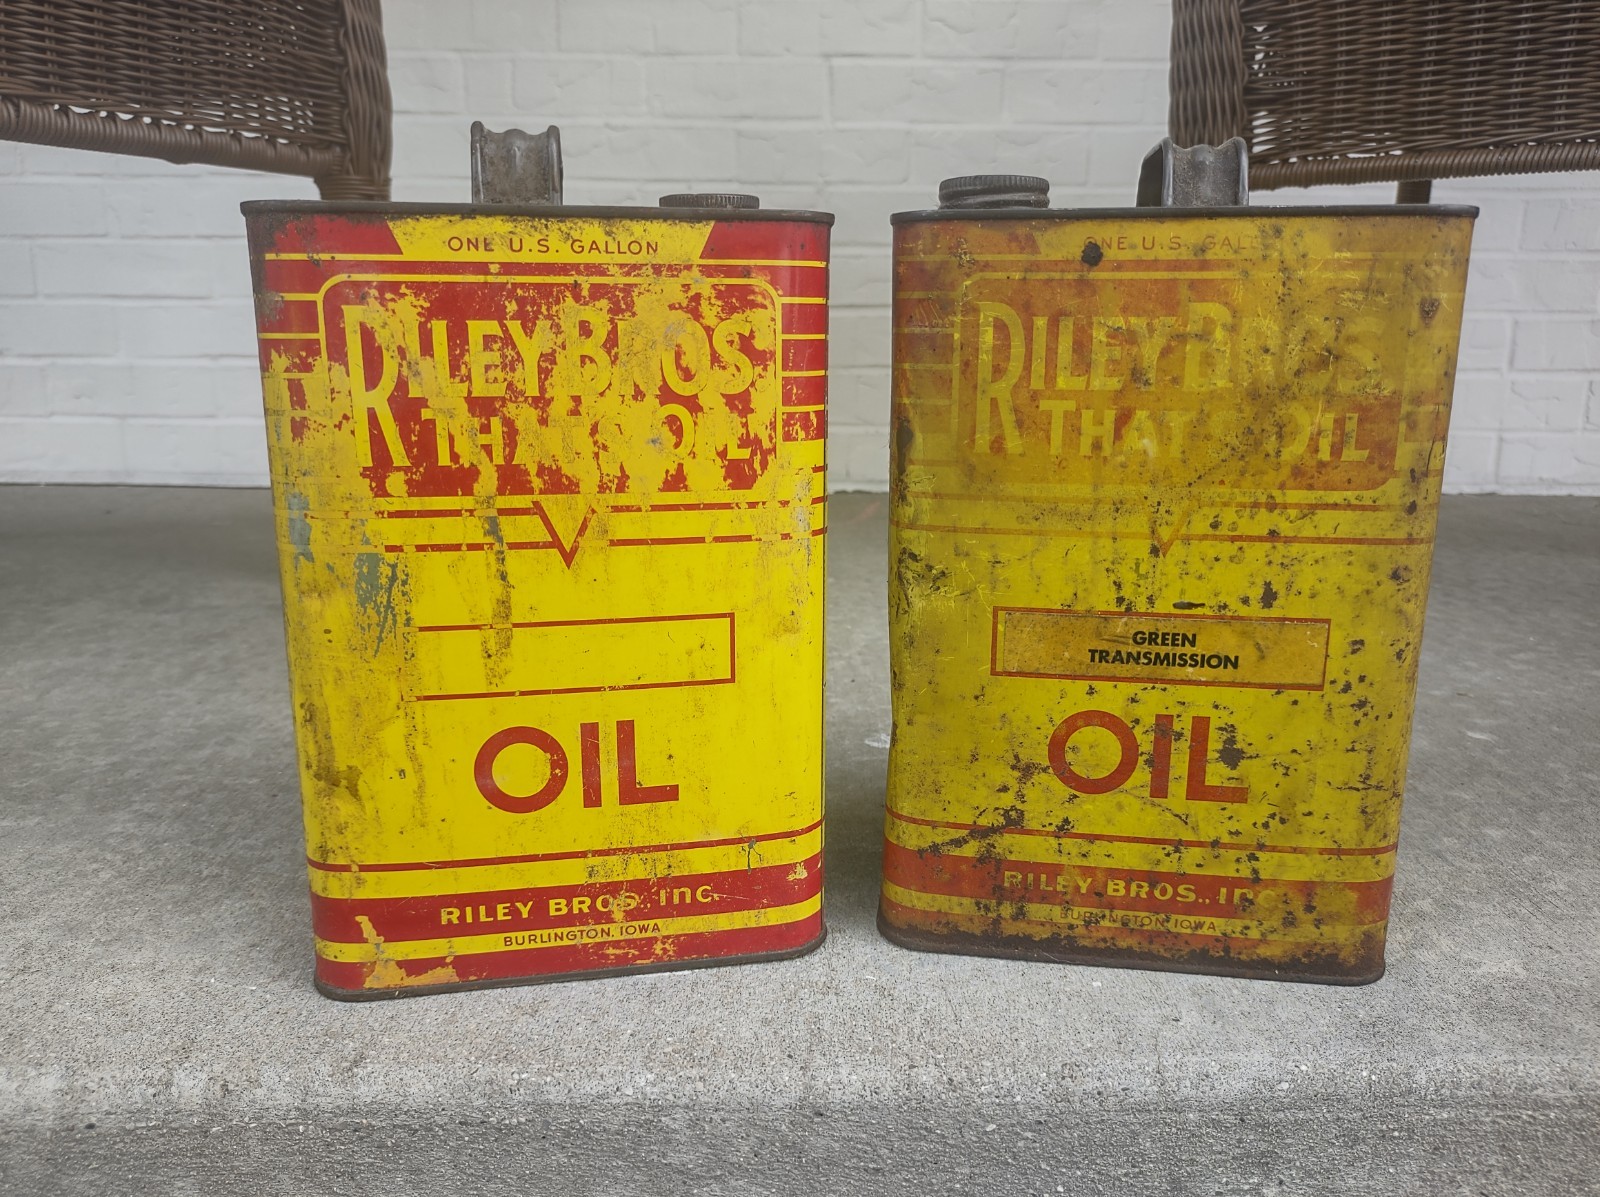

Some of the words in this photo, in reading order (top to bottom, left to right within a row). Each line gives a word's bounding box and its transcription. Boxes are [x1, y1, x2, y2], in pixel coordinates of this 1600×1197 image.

[448, 236, 495, 252] ONE
[509, 237, 560, 254] U.S.
[570, 238, 659, 256] GALLON
[341, 304, 551, 467] RILEY
[974, 302, 1177, 454] RILEY
[1132, 631, 1197, 648] GREEN
[1088, 649, 1239, 670] TRANSMISSION
[474, 719, 679, 814] OIL
[1047, 709, 1248, 804] OIL
[1003, 870, 1093, 894] RILEY
[441, 901, 533, 925] RILEY
[1174, 918, 1217, 932] IOWA
[619, 922, 661, 937] IOWA
